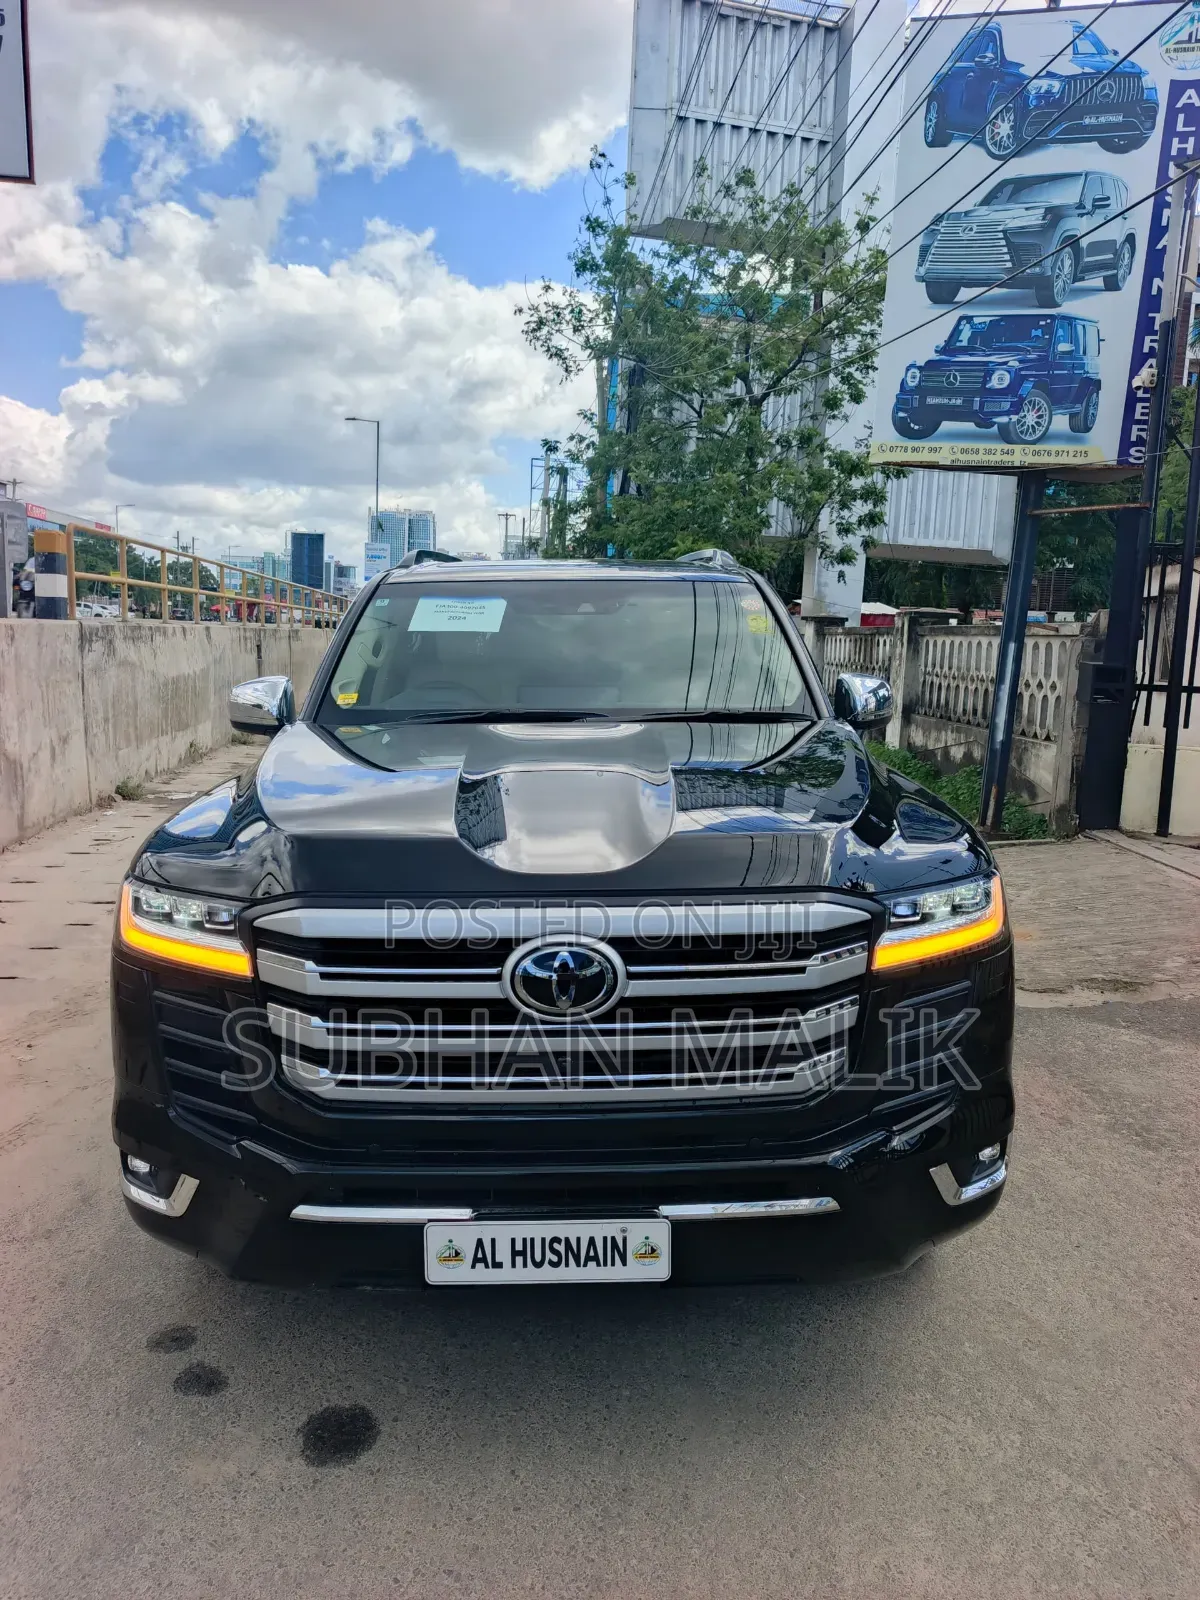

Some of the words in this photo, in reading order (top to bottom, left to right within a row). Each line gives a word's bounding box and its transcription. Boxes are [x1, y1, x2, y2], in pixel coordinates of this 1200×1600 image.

[1128, 312, 1160, 464] TRAERS
[889, 445, 909, 453] 0778
[910, 446, 925, 454] 907
[927, 446, 943, 454] 997
[960, 447, 980, 455] 0658
[982, 448, 998, 456] 382
[1000, 448, 1015, 456] 549
[1031, 449, 1052, 457] 0676
[1054, 449, 1070, 458] 971
[1072, 450, 1089, 458] 215
[470, 1237, 504, 1270] AL
[510, 1235, 628, 1269] HUSNAIN
